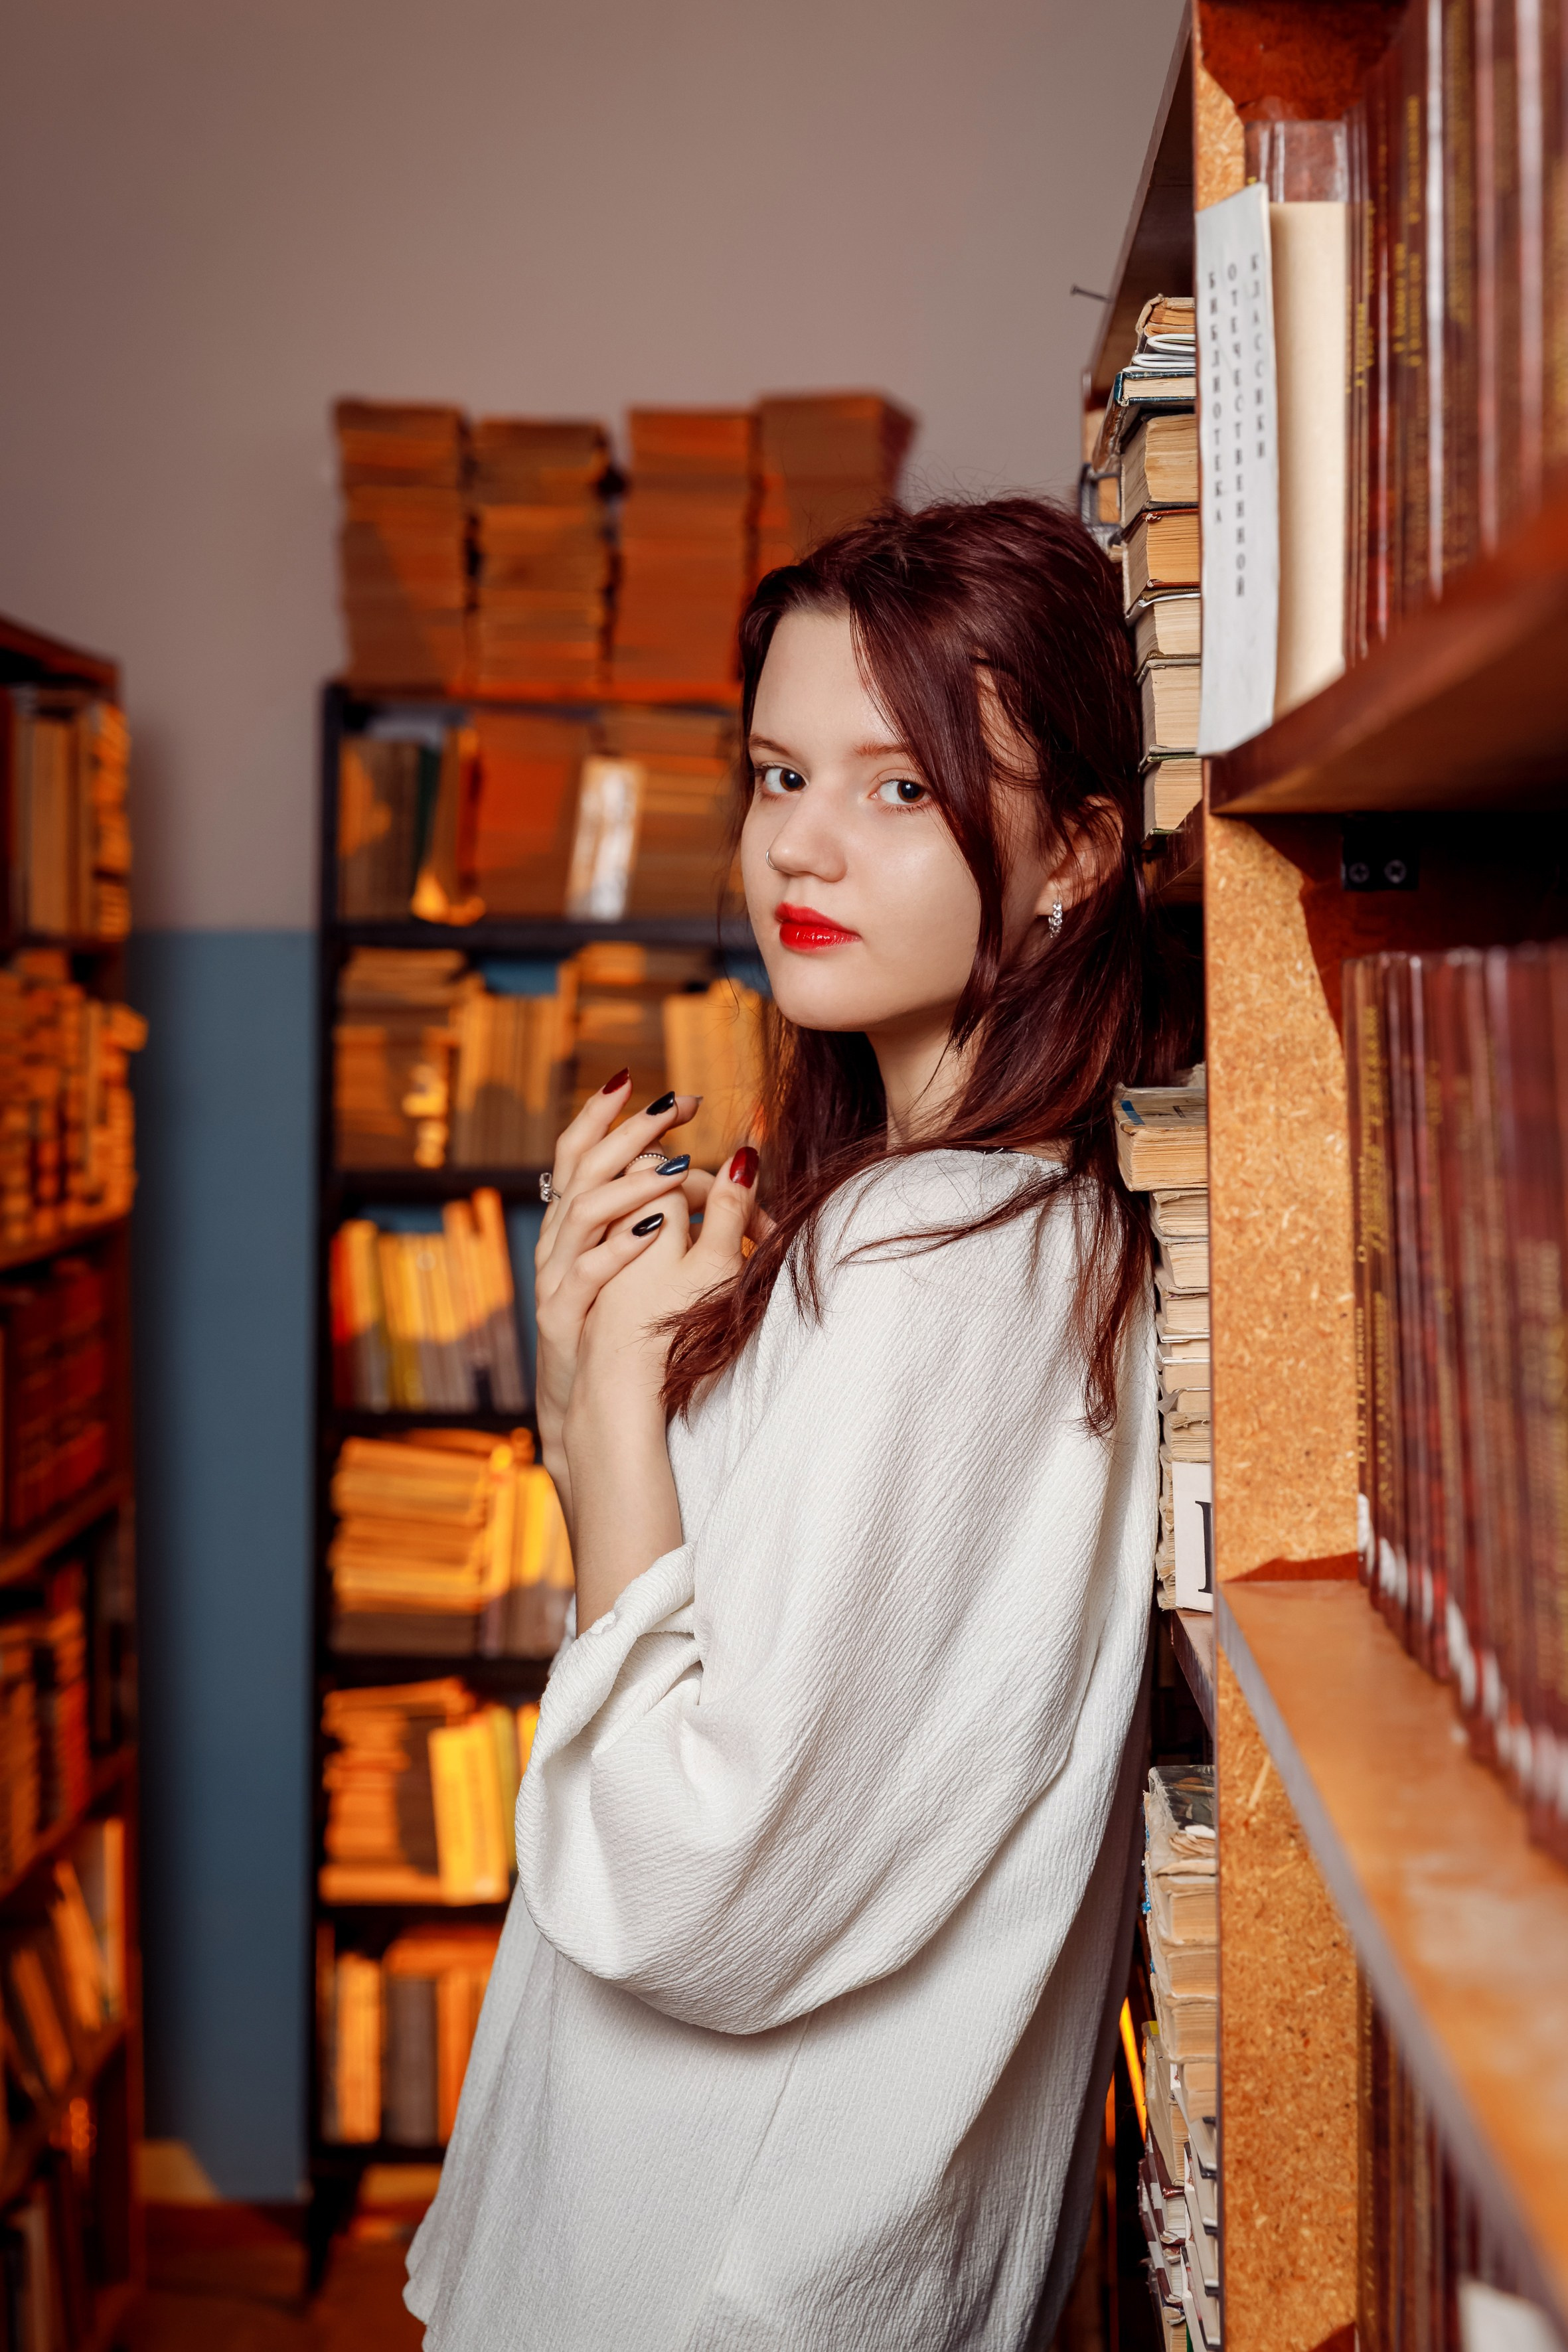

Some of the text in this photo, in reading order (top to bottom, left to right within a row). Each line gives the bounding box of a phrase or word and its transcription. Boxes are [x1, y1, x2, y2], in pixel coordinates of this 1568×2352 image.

[1208, 272, 1223, 523] БИБЛИОТЕКА
[1227, 264, 1245, 597] ОТЕЧЕСТВЕННОЙ
[1250, 254, 1265, 459] КЛАССИКИ
